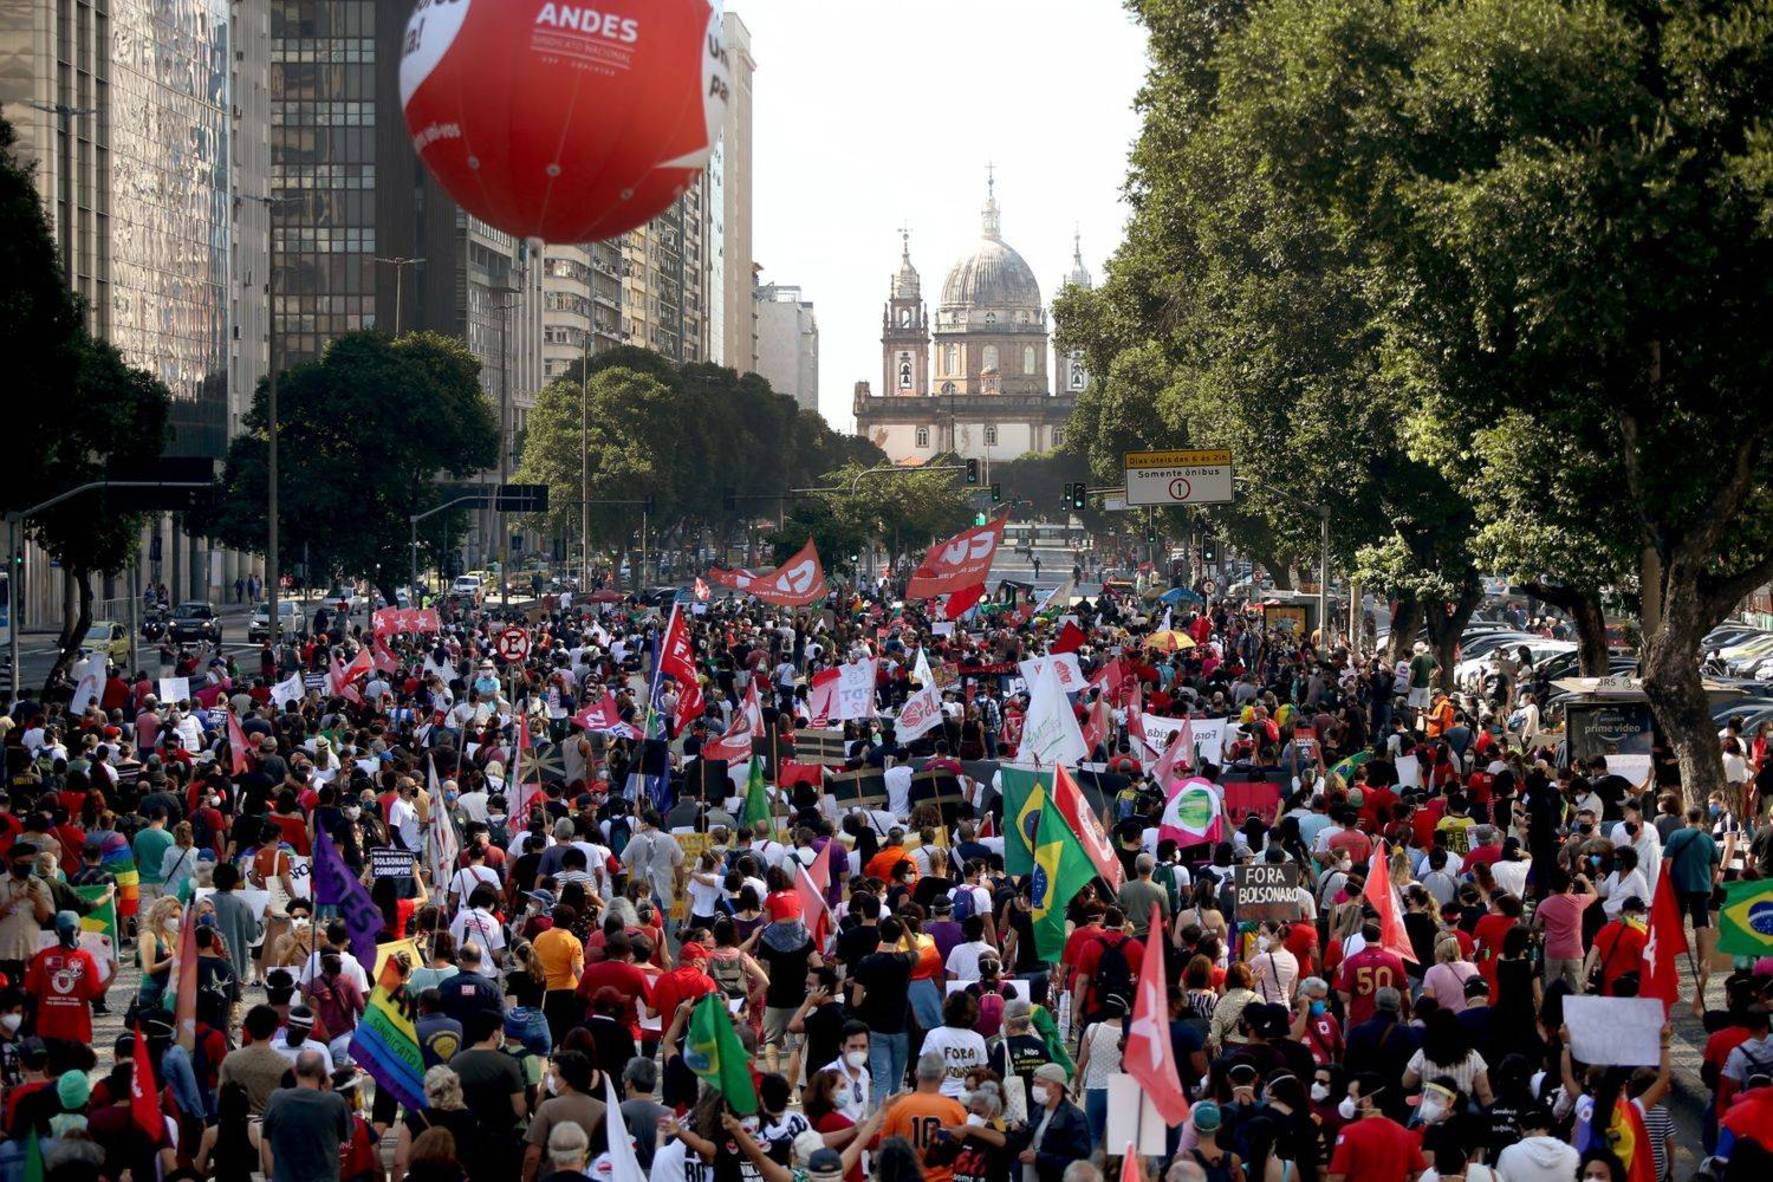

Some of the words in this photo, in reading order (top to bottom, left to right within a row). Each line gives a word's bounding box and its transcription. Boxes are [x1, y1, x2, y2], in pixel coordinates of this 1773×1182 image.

[536, 2, 640, 43] ANDES
[1138, 470, 1183, 479] Somente
[1185, 468, 1220, 477] ônibus
[1584, 724, 1613, 735] prime
[1615, 722, 1641, 733] video
[374, 857, 413, 866] BOLSONARO
[374, 867, 411, 876] CORRUPTO!
[1245, 867, 1286, 884] FORA
[1239, 886, 1299, 904] BOLSONARO
[1357, 965, 1393, 996] 50
[944, 1046, 976, 1059] FORA
